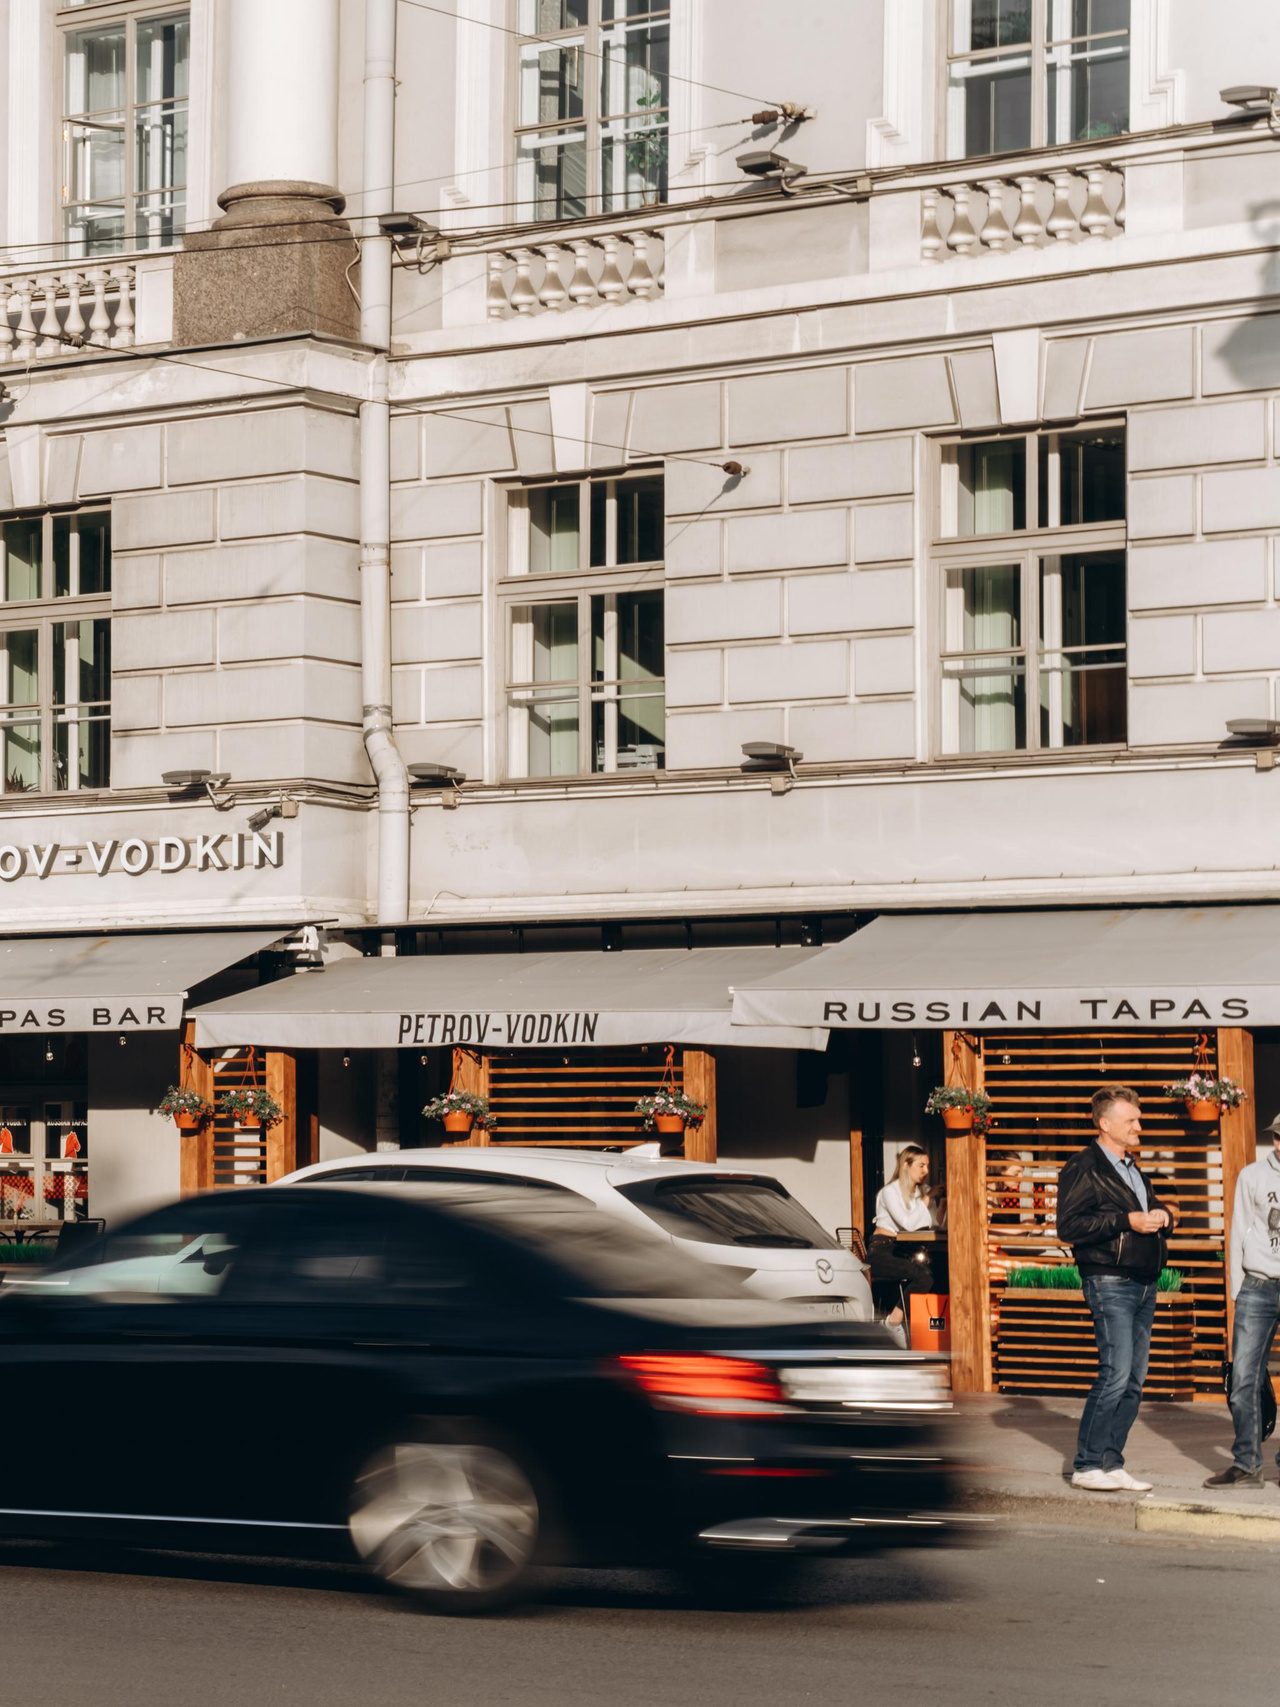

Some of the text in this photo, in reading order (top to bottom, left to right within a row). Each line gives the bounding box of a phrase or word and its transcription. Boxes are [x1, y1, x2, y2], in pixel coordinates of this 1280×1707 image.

[92, 1006, 167, 1026] BAR
[823, 998, 1249, 1022] RUSSIAN TAPAS
[398, 1013, 599, 1044] PETROV-VODKIN
